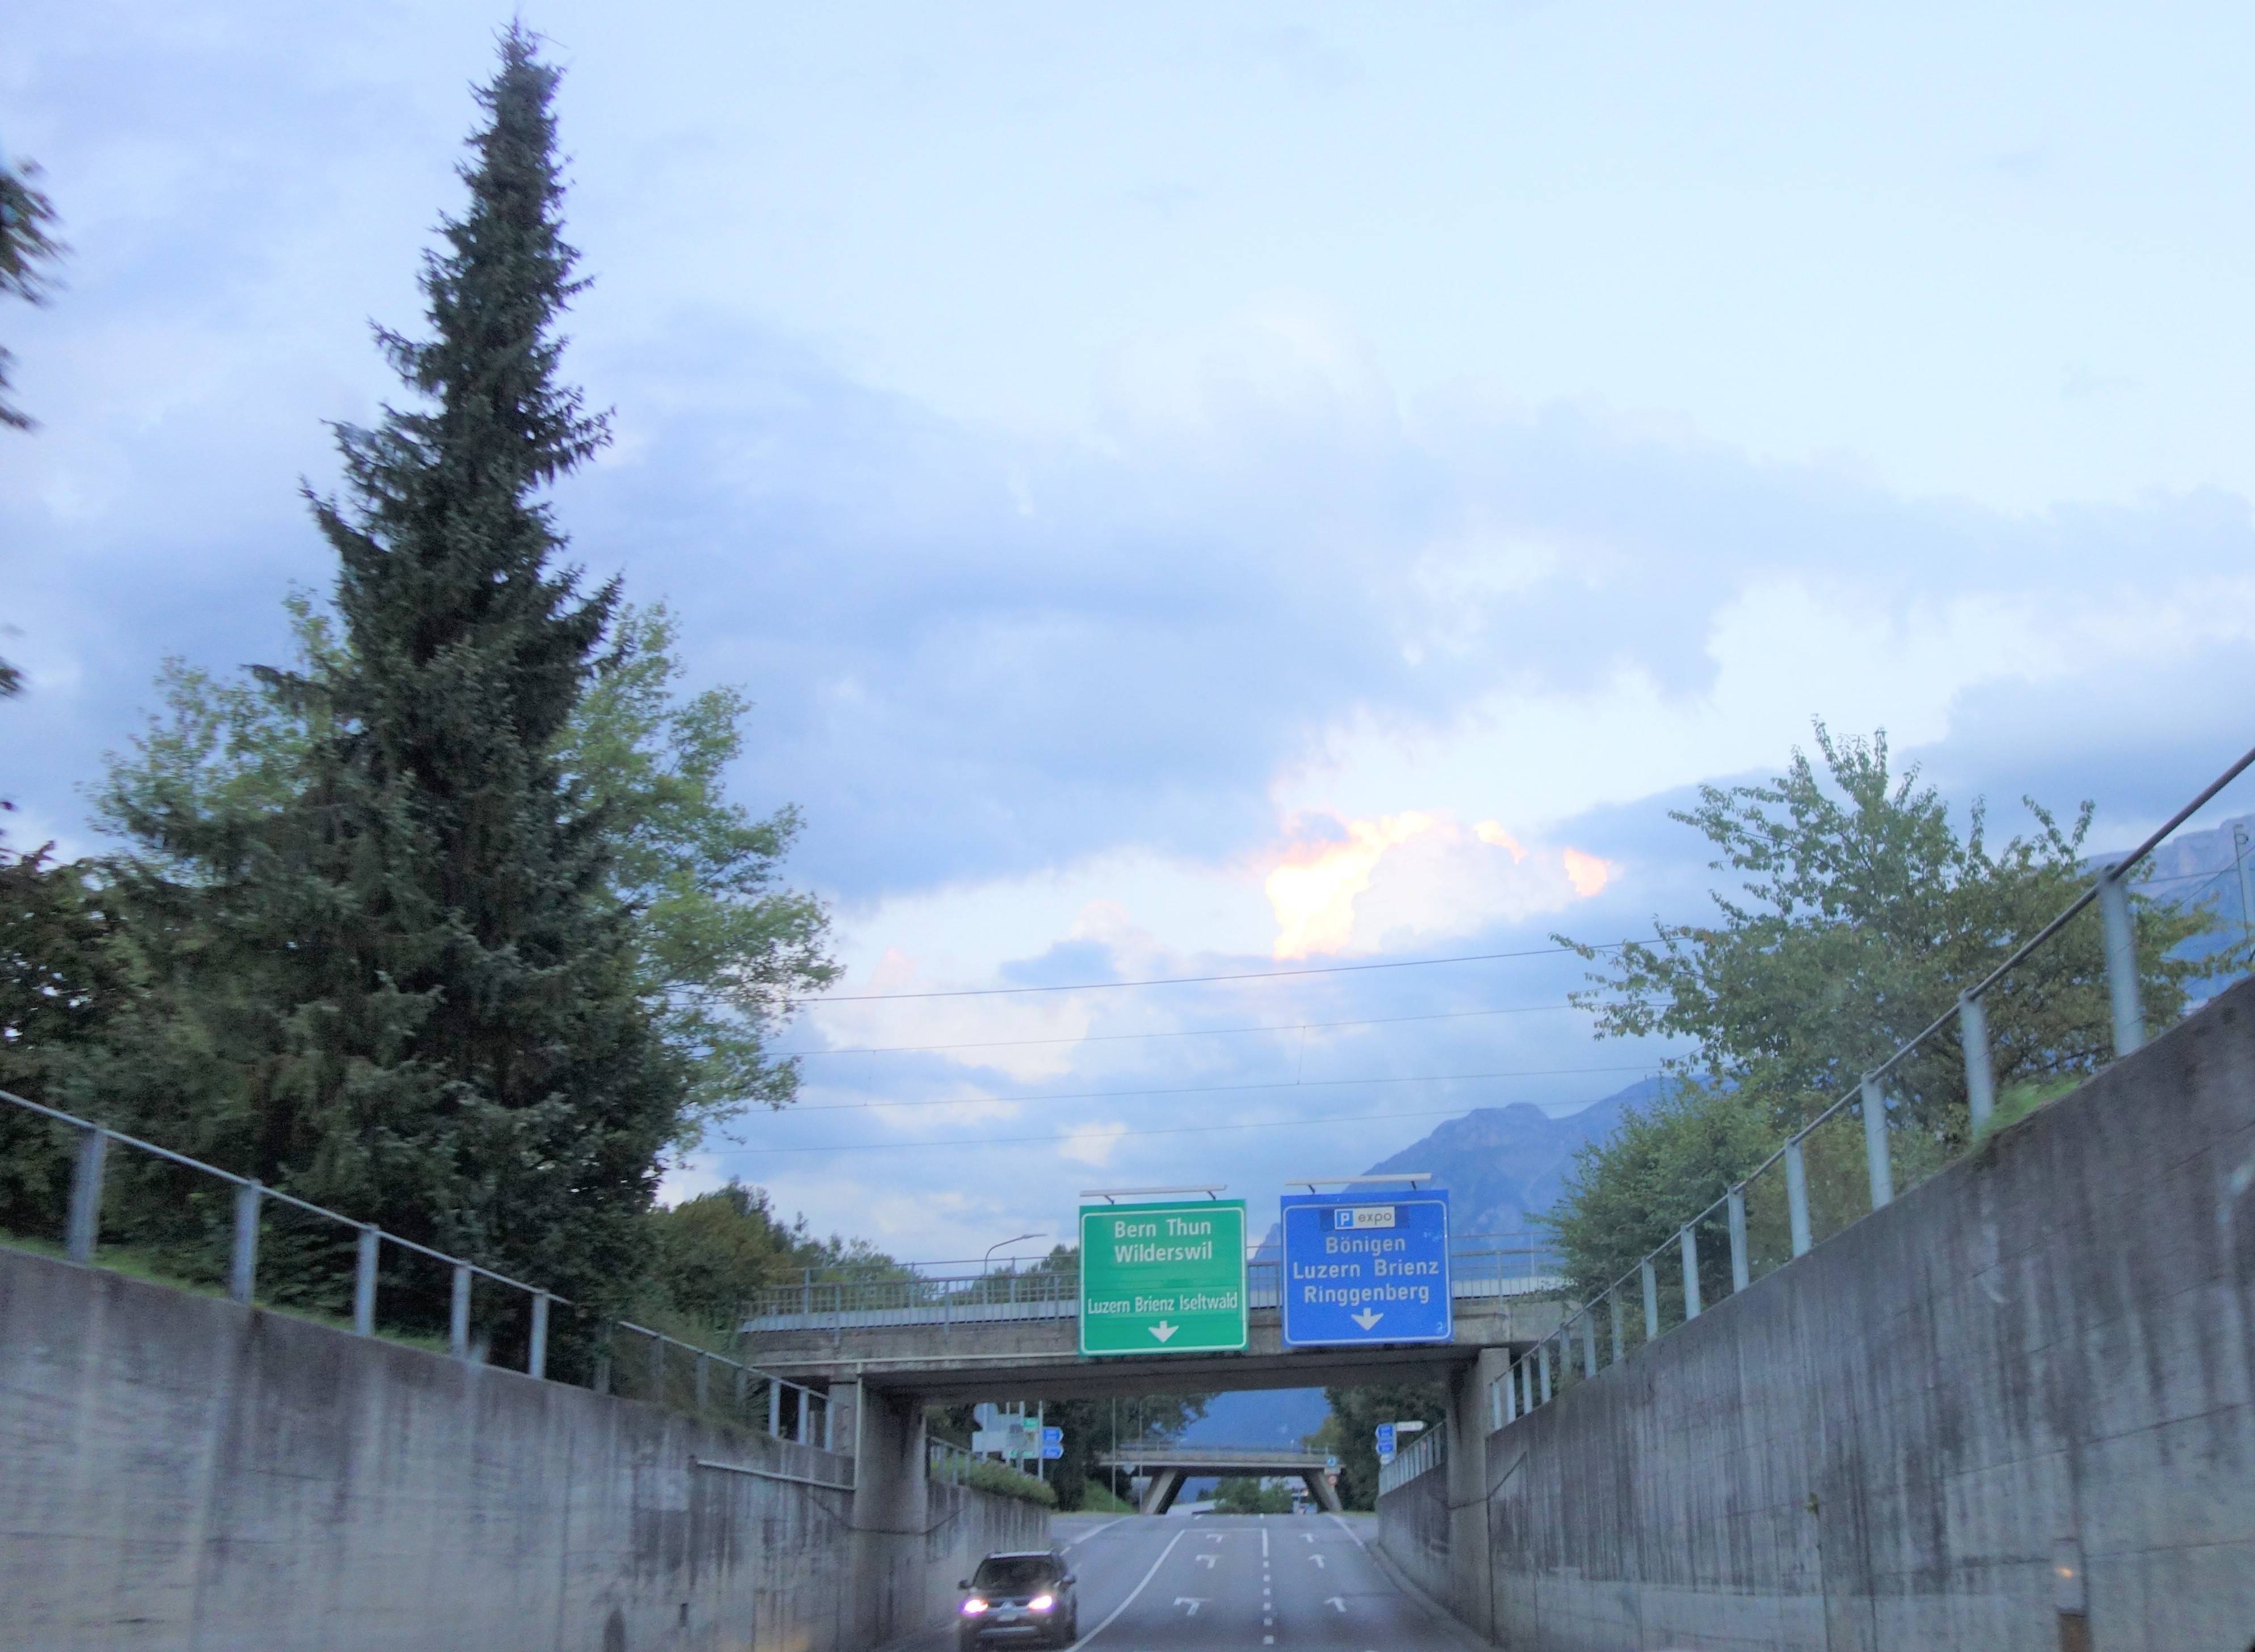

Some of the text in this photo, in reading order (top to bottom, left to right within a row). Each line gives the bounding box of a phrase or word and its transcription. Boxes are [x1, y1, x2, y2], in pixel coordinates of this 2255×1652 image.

[1114, 1218, 1211, 1238] Bern Thun
[1340, 1211, 1392, 1226] P expo
[1114, 1241, 1213, 1263] Wilderswil
[1325, 1236, 1405, 1256] Bönigen
[1293, 1258, 1439, 1279] Luzern Brienz
[1087, 1291, 1238, 1315] Luzern Brienz Iseltwald
[1304, 1283, 1429, 1307] Ringgenberg
